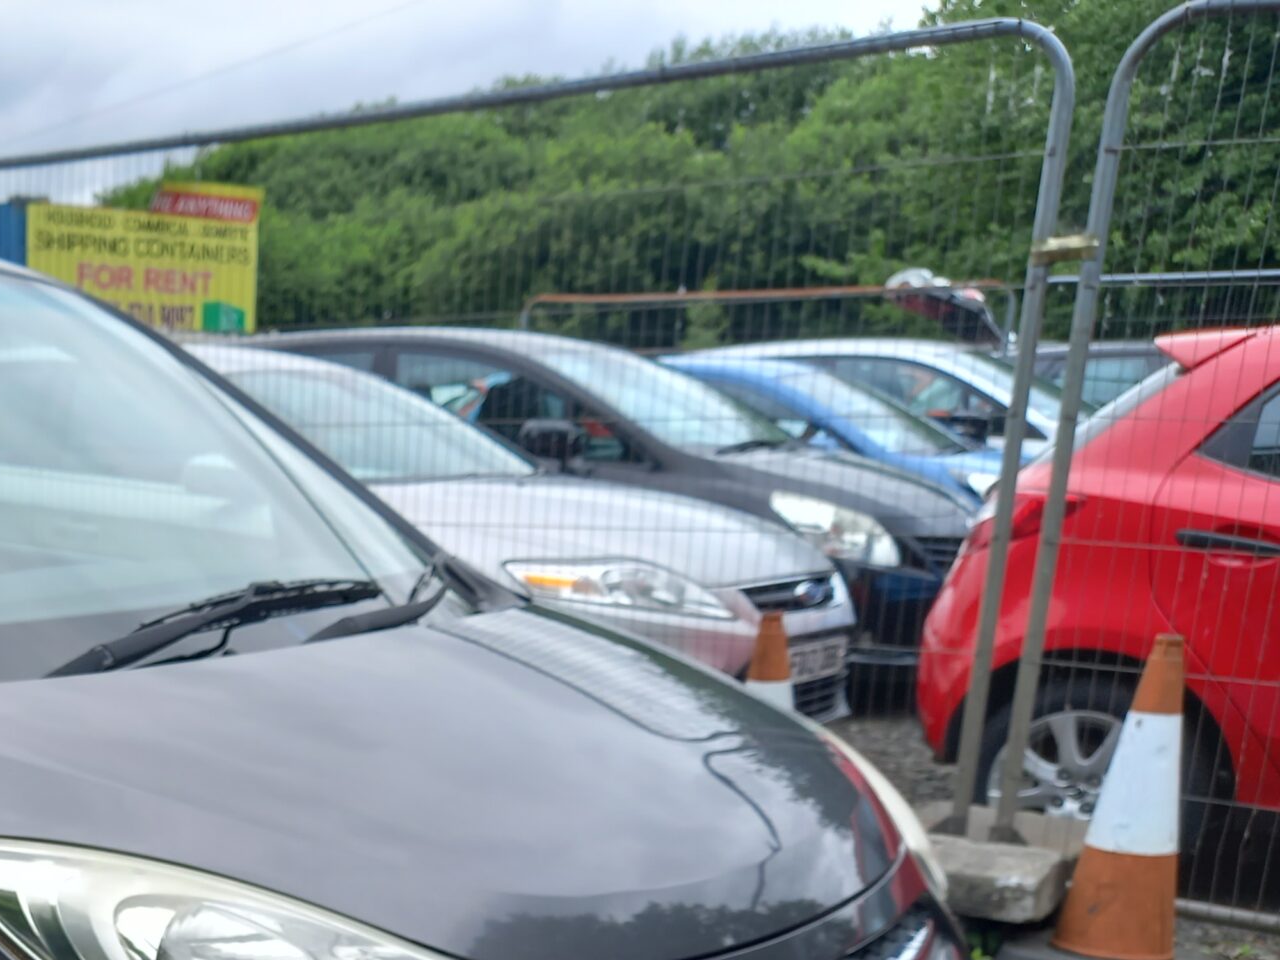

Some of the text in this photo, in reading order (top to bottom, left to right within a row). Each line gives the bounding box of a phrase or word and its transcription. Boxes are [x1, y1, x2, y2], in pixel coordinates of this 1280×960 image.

[34, 229, 251, 266] SHIPPING CONTAINERS
[77, 262, 213, 296] FOR RENT
